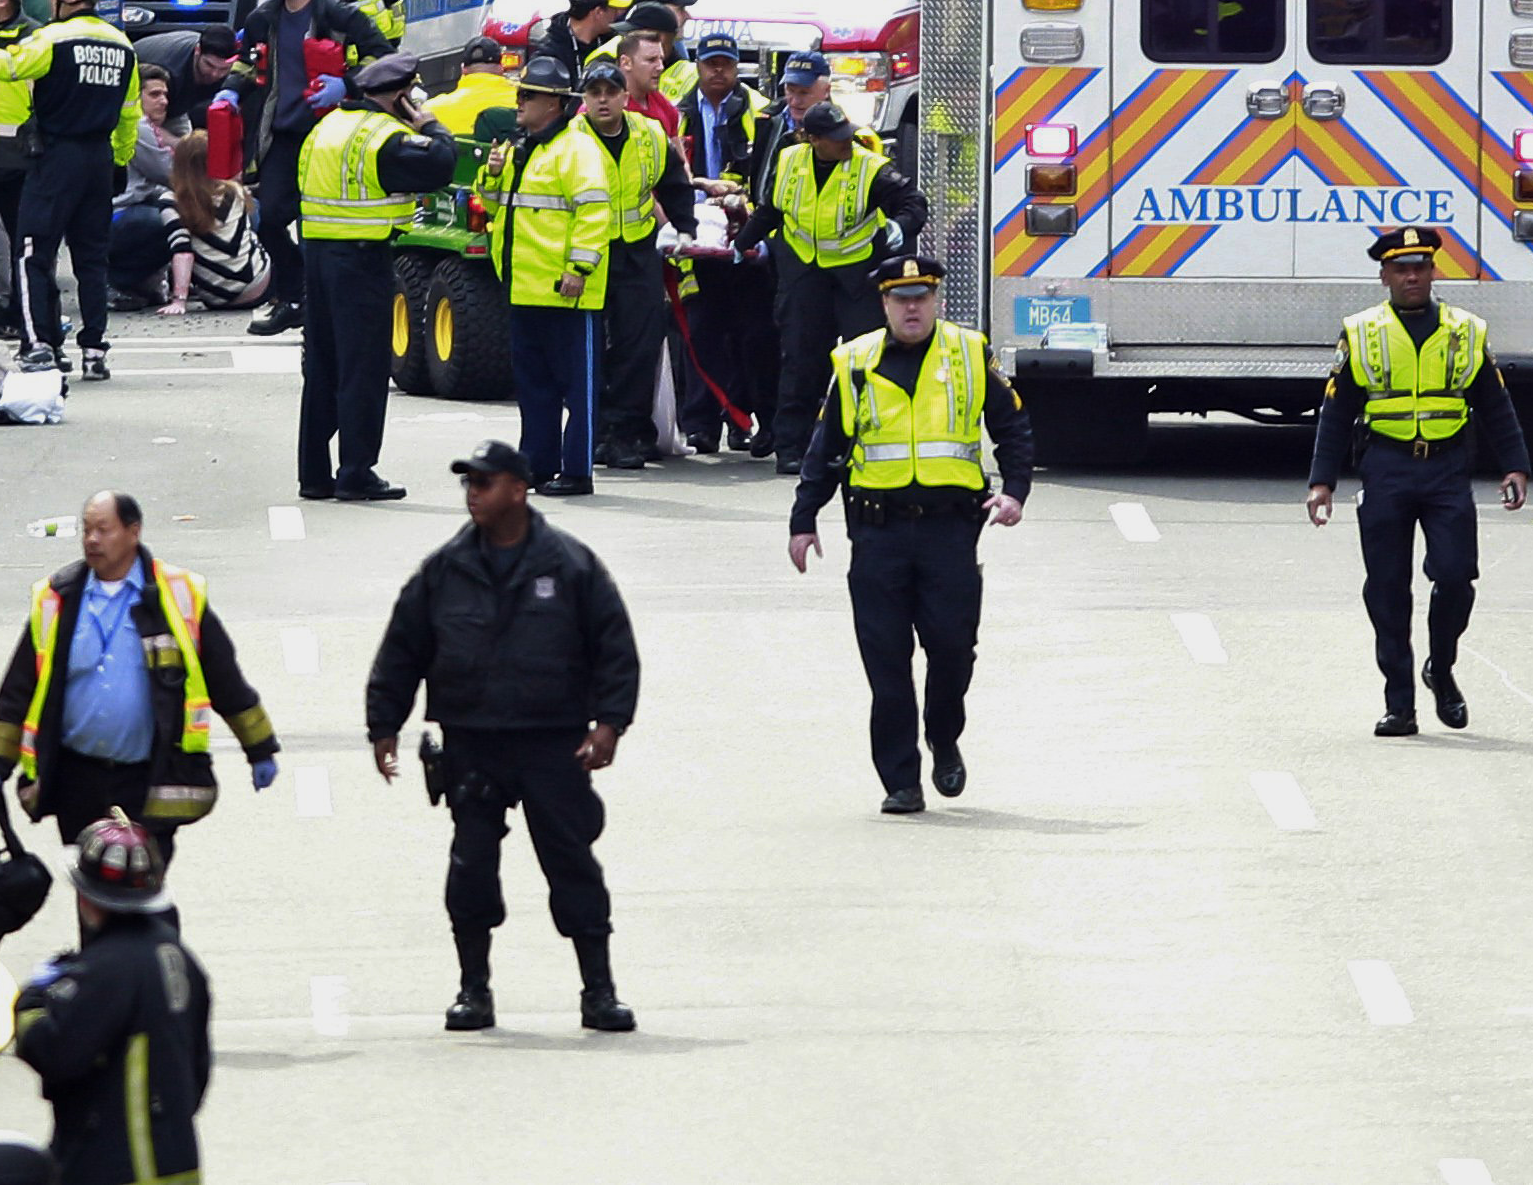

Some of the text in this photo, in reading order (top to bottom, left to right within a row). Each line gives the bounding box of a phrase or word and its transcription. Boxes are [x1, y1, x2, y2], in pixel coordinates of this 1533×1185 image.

[73, 45, 126, 68] BOSTON
[78, 64, 122, 86] POLICE
[1131, 188, 1455, 224] AMBULANCE
[1029, 306, 1071, 326] MB64
[951, 346, 965, 416] POLICE
